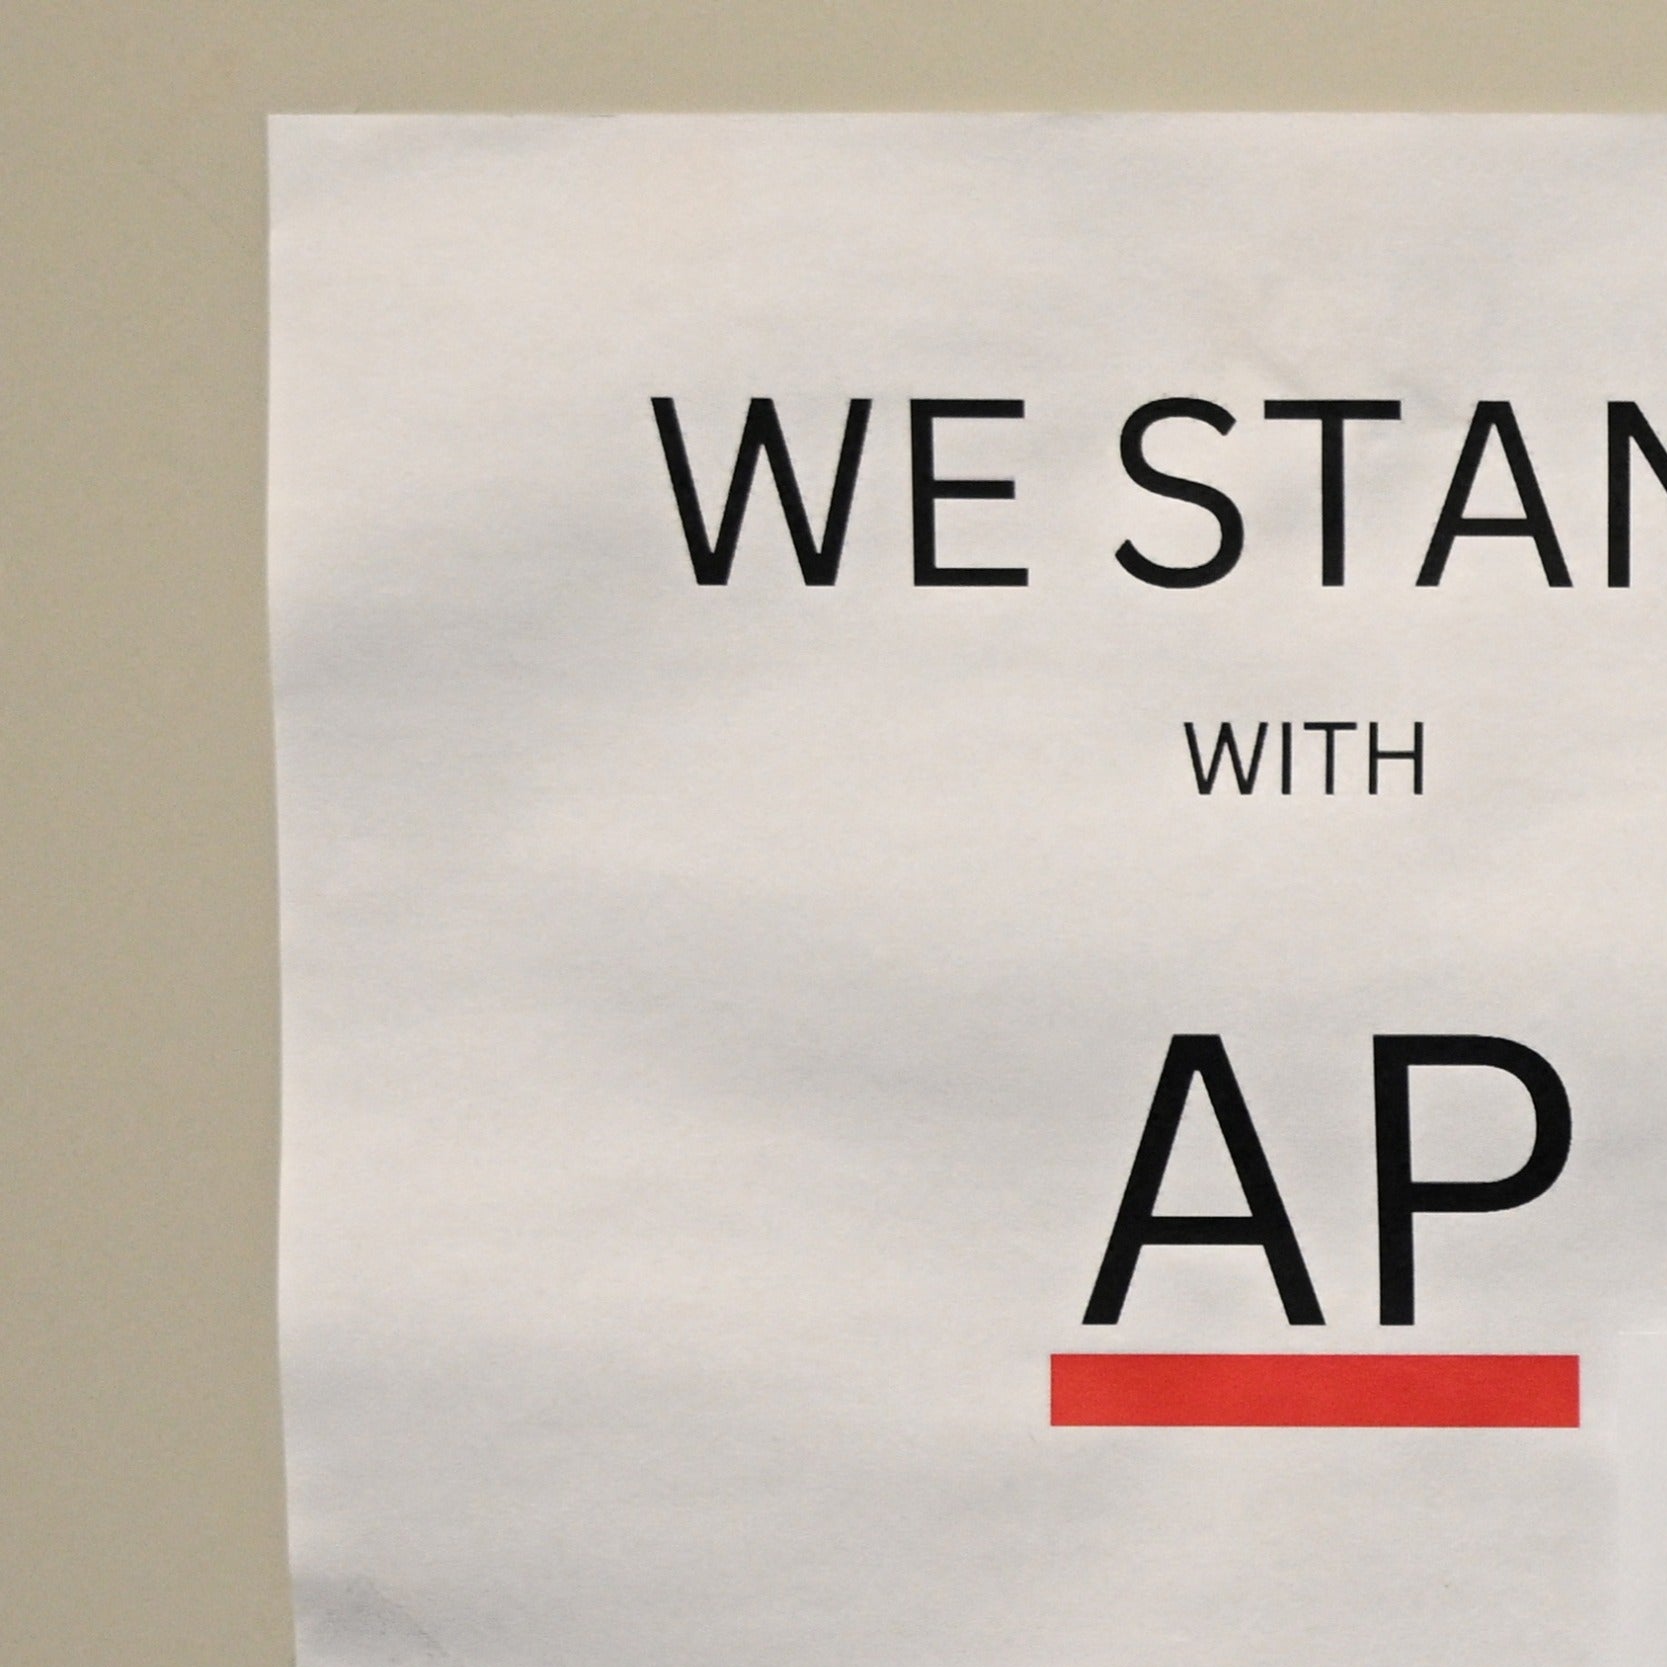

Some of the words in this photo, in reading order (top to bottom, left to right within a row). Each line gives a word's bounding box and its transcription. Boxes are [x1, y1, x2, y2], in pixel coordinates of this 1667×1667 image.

[651, 397, 1028, 586] WE
[1184, 722, 1423, 795] WITH
[1082, 1034, 1571, 1325] AP
